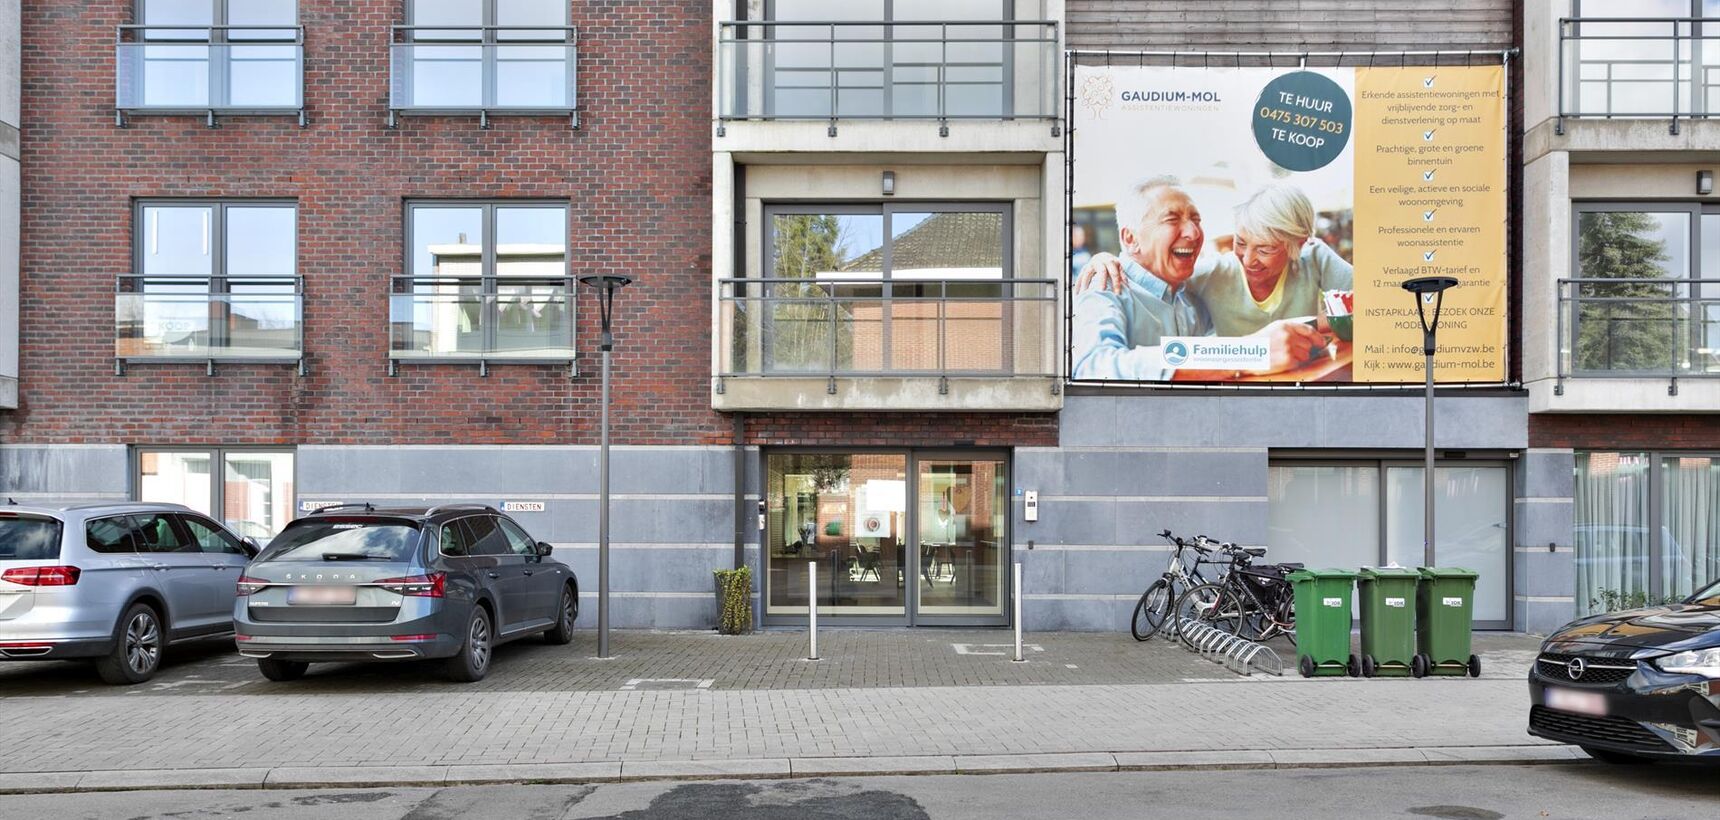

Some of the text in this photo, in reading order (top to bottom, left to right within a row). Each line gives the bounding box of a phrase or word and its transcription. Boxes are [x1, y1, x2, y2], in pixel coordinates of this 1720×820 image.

[1121, 91, 1222, 102] GAUDIUM-MOL
[1397, 91, 1480, 100] assistentiewoningen
[1279, 92, 1334, 113] TE HUUR
[1387, 104, 1437, 113] vrijblijvende
[1260, 107, 1344, 134] 0475 307 503
[1381, 116, 1445, 125] dienstverlening
[1272, 128, 1325, 149] TE KOOP
[1376, 145, 1417, 154] Prachtige,
[1418, 146, 1441, 154] grote
[1387, 185, 1416, 194] veilige,
[1399, 198, 1463, 207] woonomgeving
[1383, 267, 1419, 276] Verlaagd
[1422, 266, 1467, 274] BTW-tarief
[1469, 307, 1495, 316] ONZE
[1194, 344, 1267, 357] Familiehulp
[1365, 345, 1385, 353] Mail
[1392, 345, 1495, 355] info@gdiumvzw.be
[1364, 361, 1380, 371] Kijk
[1388, 361, 1495, 371] www.gadium-mol.be
